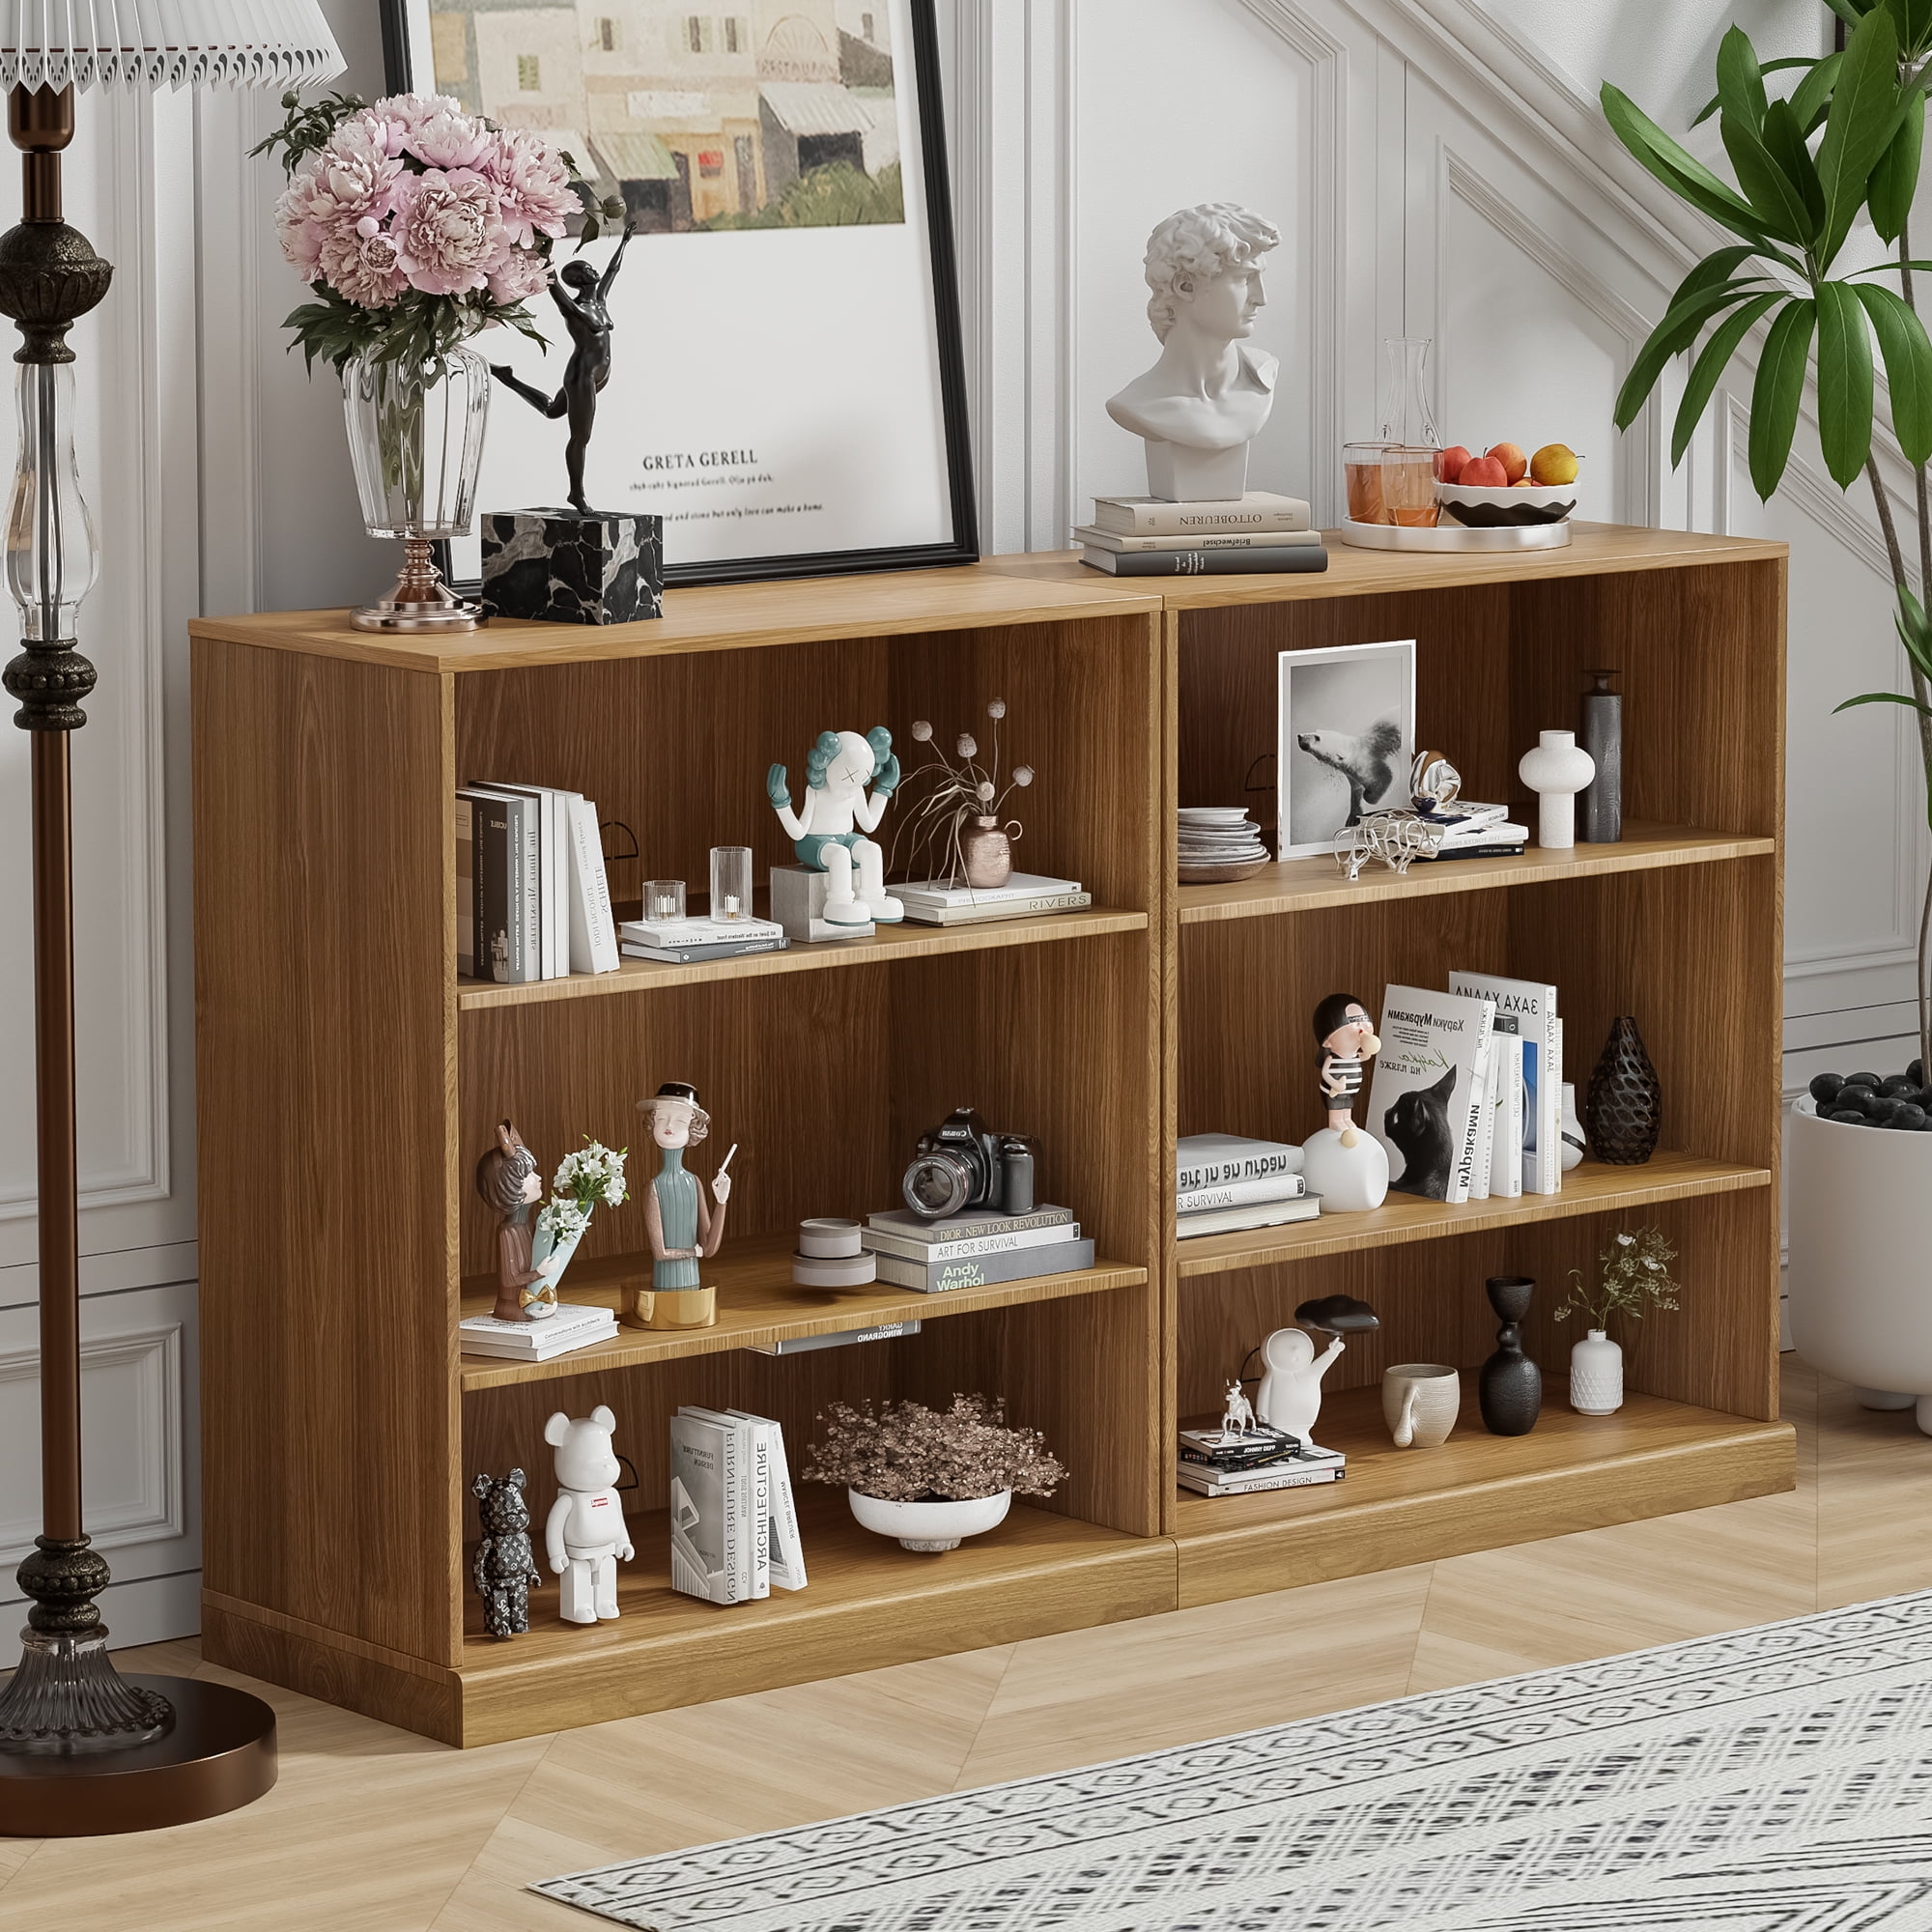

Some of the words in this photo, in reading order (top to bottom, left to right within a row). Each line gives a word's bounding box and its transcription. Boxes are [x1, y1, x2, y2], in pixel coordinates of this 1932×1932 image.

[642, 453, 695, 470] GRETA
[699, 449, 757, 467] GERELL
[1179, 514, 1263, 526] OTTOBEUREN
[1203, 537, 1251, 547] Briefwechsel
[1029, 895, 1087, 911] RIVERS
[1187, 1191, 1233, 1208] SURVIVAL
[940, 1229, 963, 1242] DIOR.
[966, 1225, 985, 1237] NEW
[987, 1221, 1012, 1234] LOOK
[1013, 1212, 1068, 1231] REVOLUTION
[937, 1244, 955, 1259] ART
[957, 1241, 977, 1256] FOR
[978, 1236, 1018, 1253] SURVIVAL
[942, 1263, 980, 1279] Andy
[936, 1273, 984, 1292] Warhol
[1244, 1479, 1280, 1492] FASHION
[1282, 1476, 1312, 1488] DESIGN
